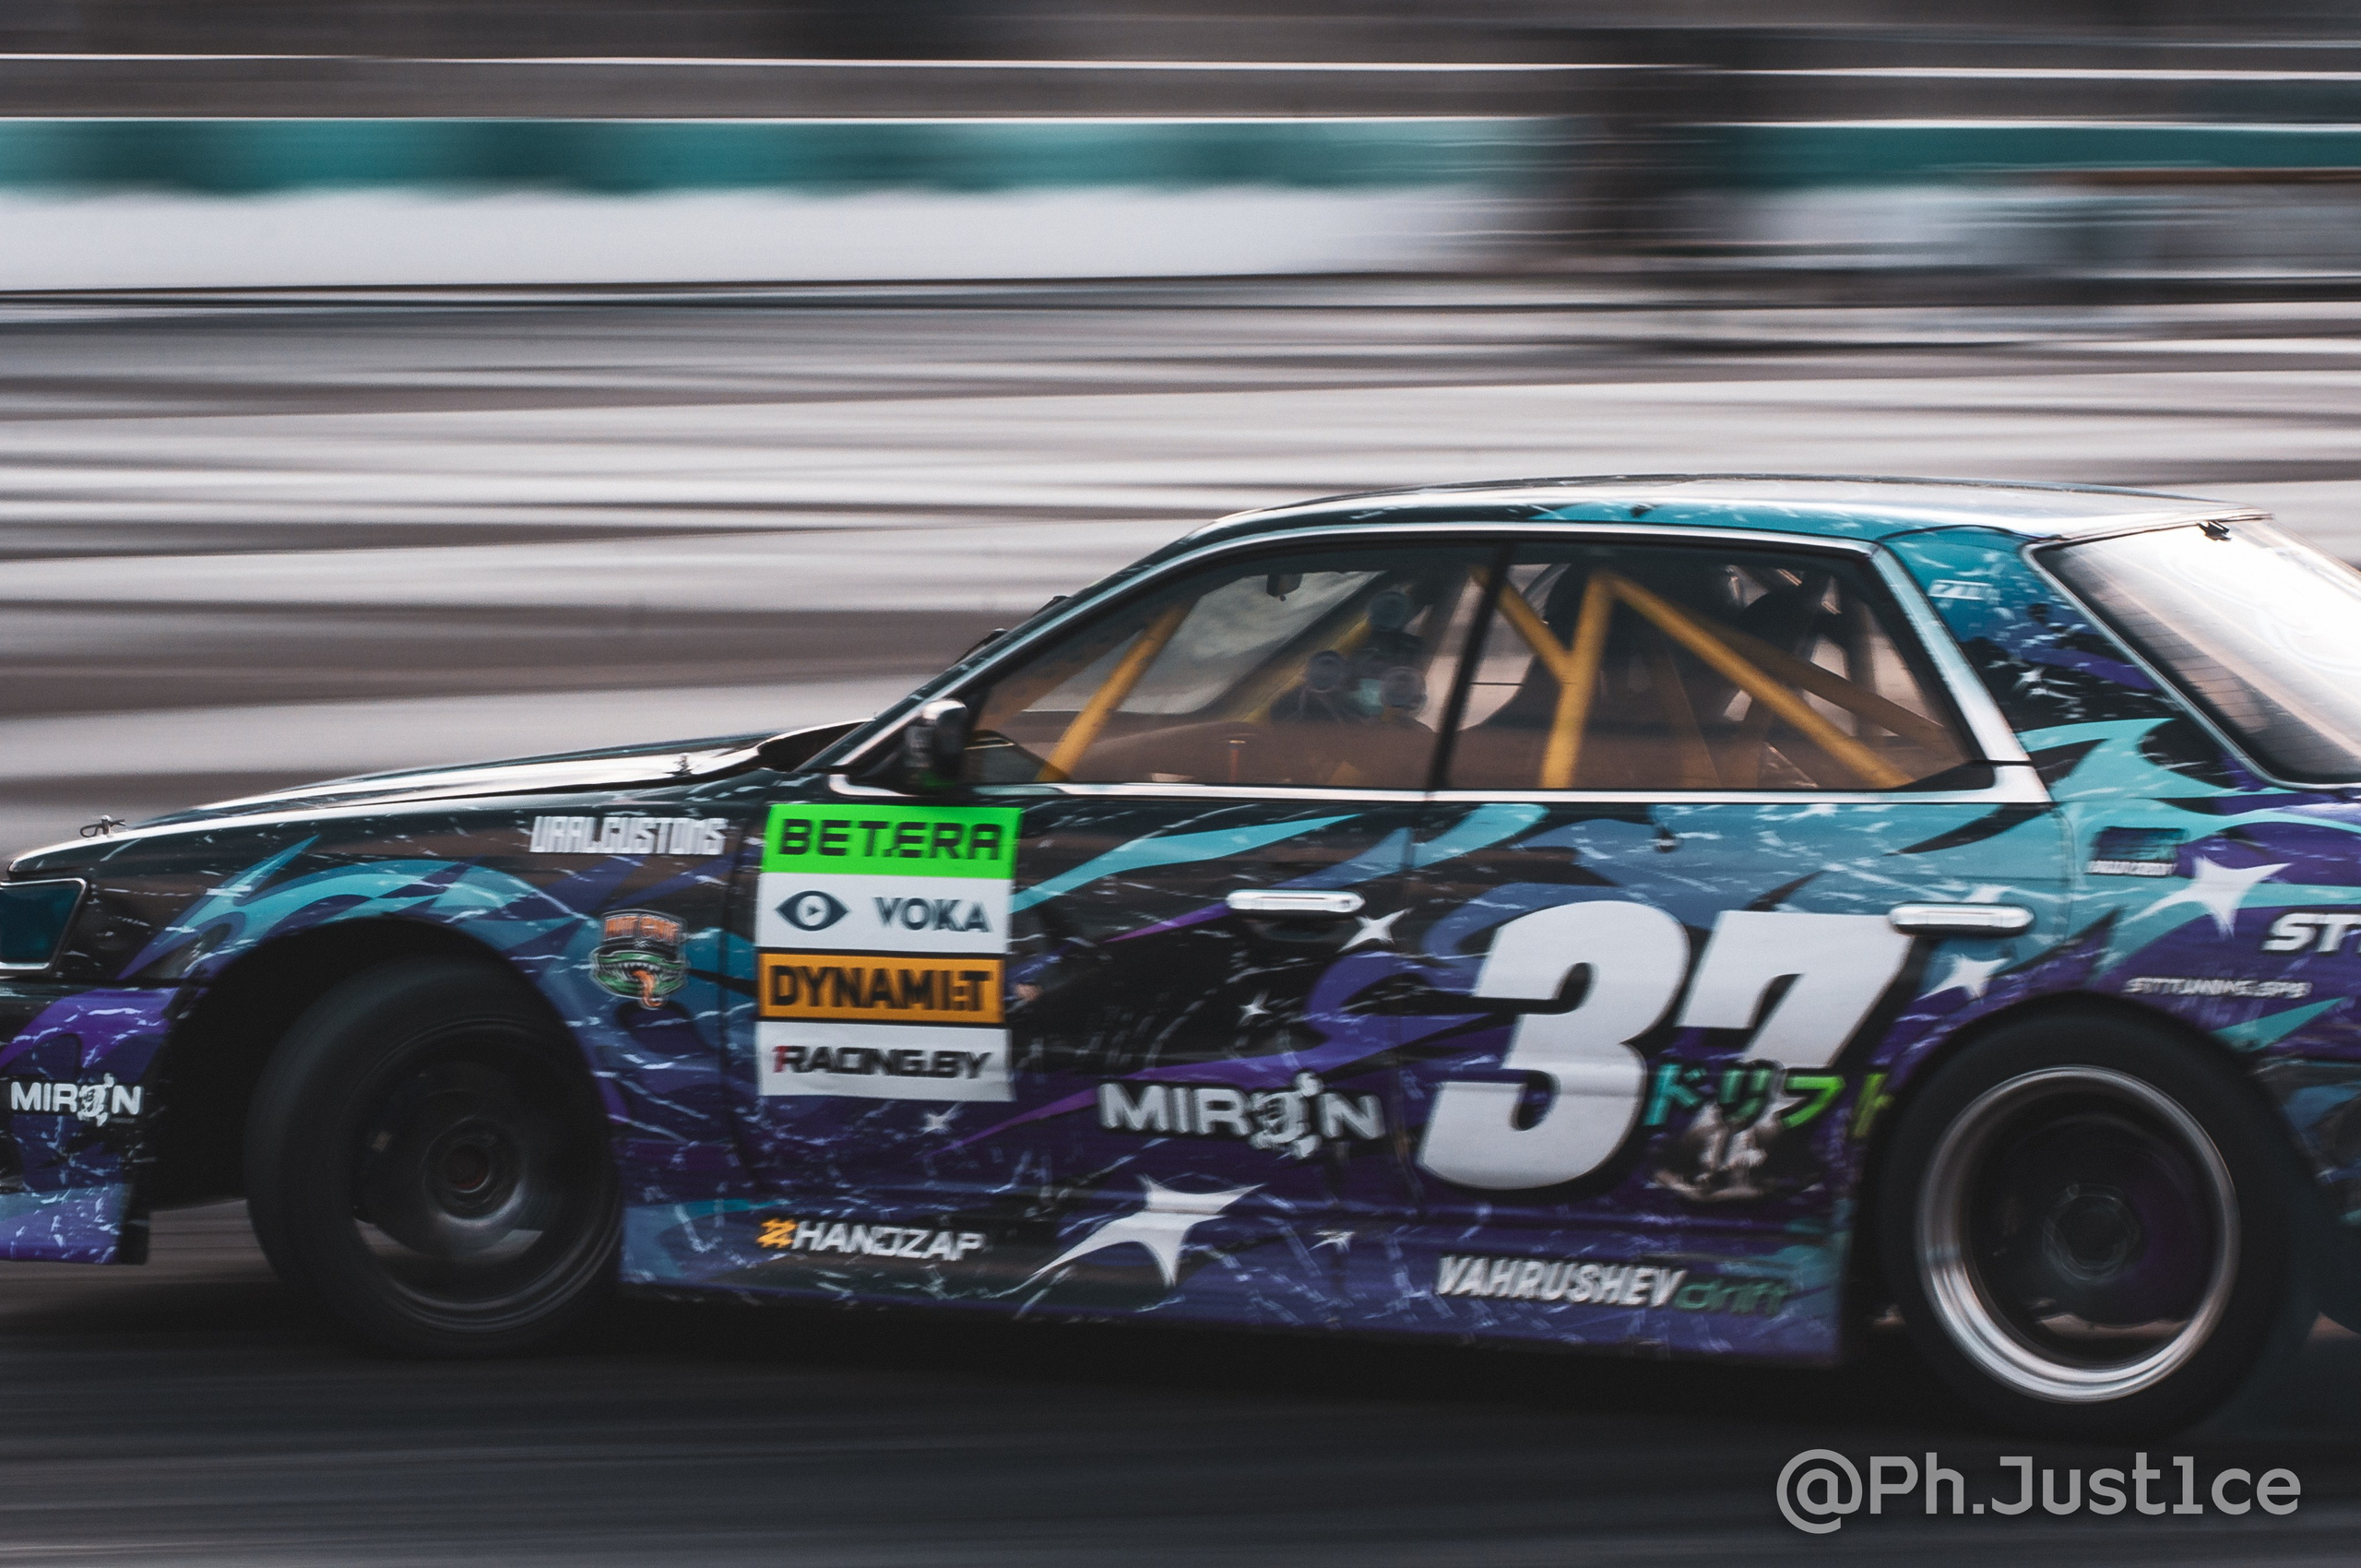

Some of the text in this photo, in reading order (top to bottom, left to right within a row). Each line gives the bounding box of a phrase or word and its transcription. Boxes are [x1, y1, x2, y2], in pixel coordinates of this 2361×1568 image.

[872, 897, 993, 932] VOKA
[2260, 913, 2361, 953] ST
[1418, 899, 1916, 1190] 37
